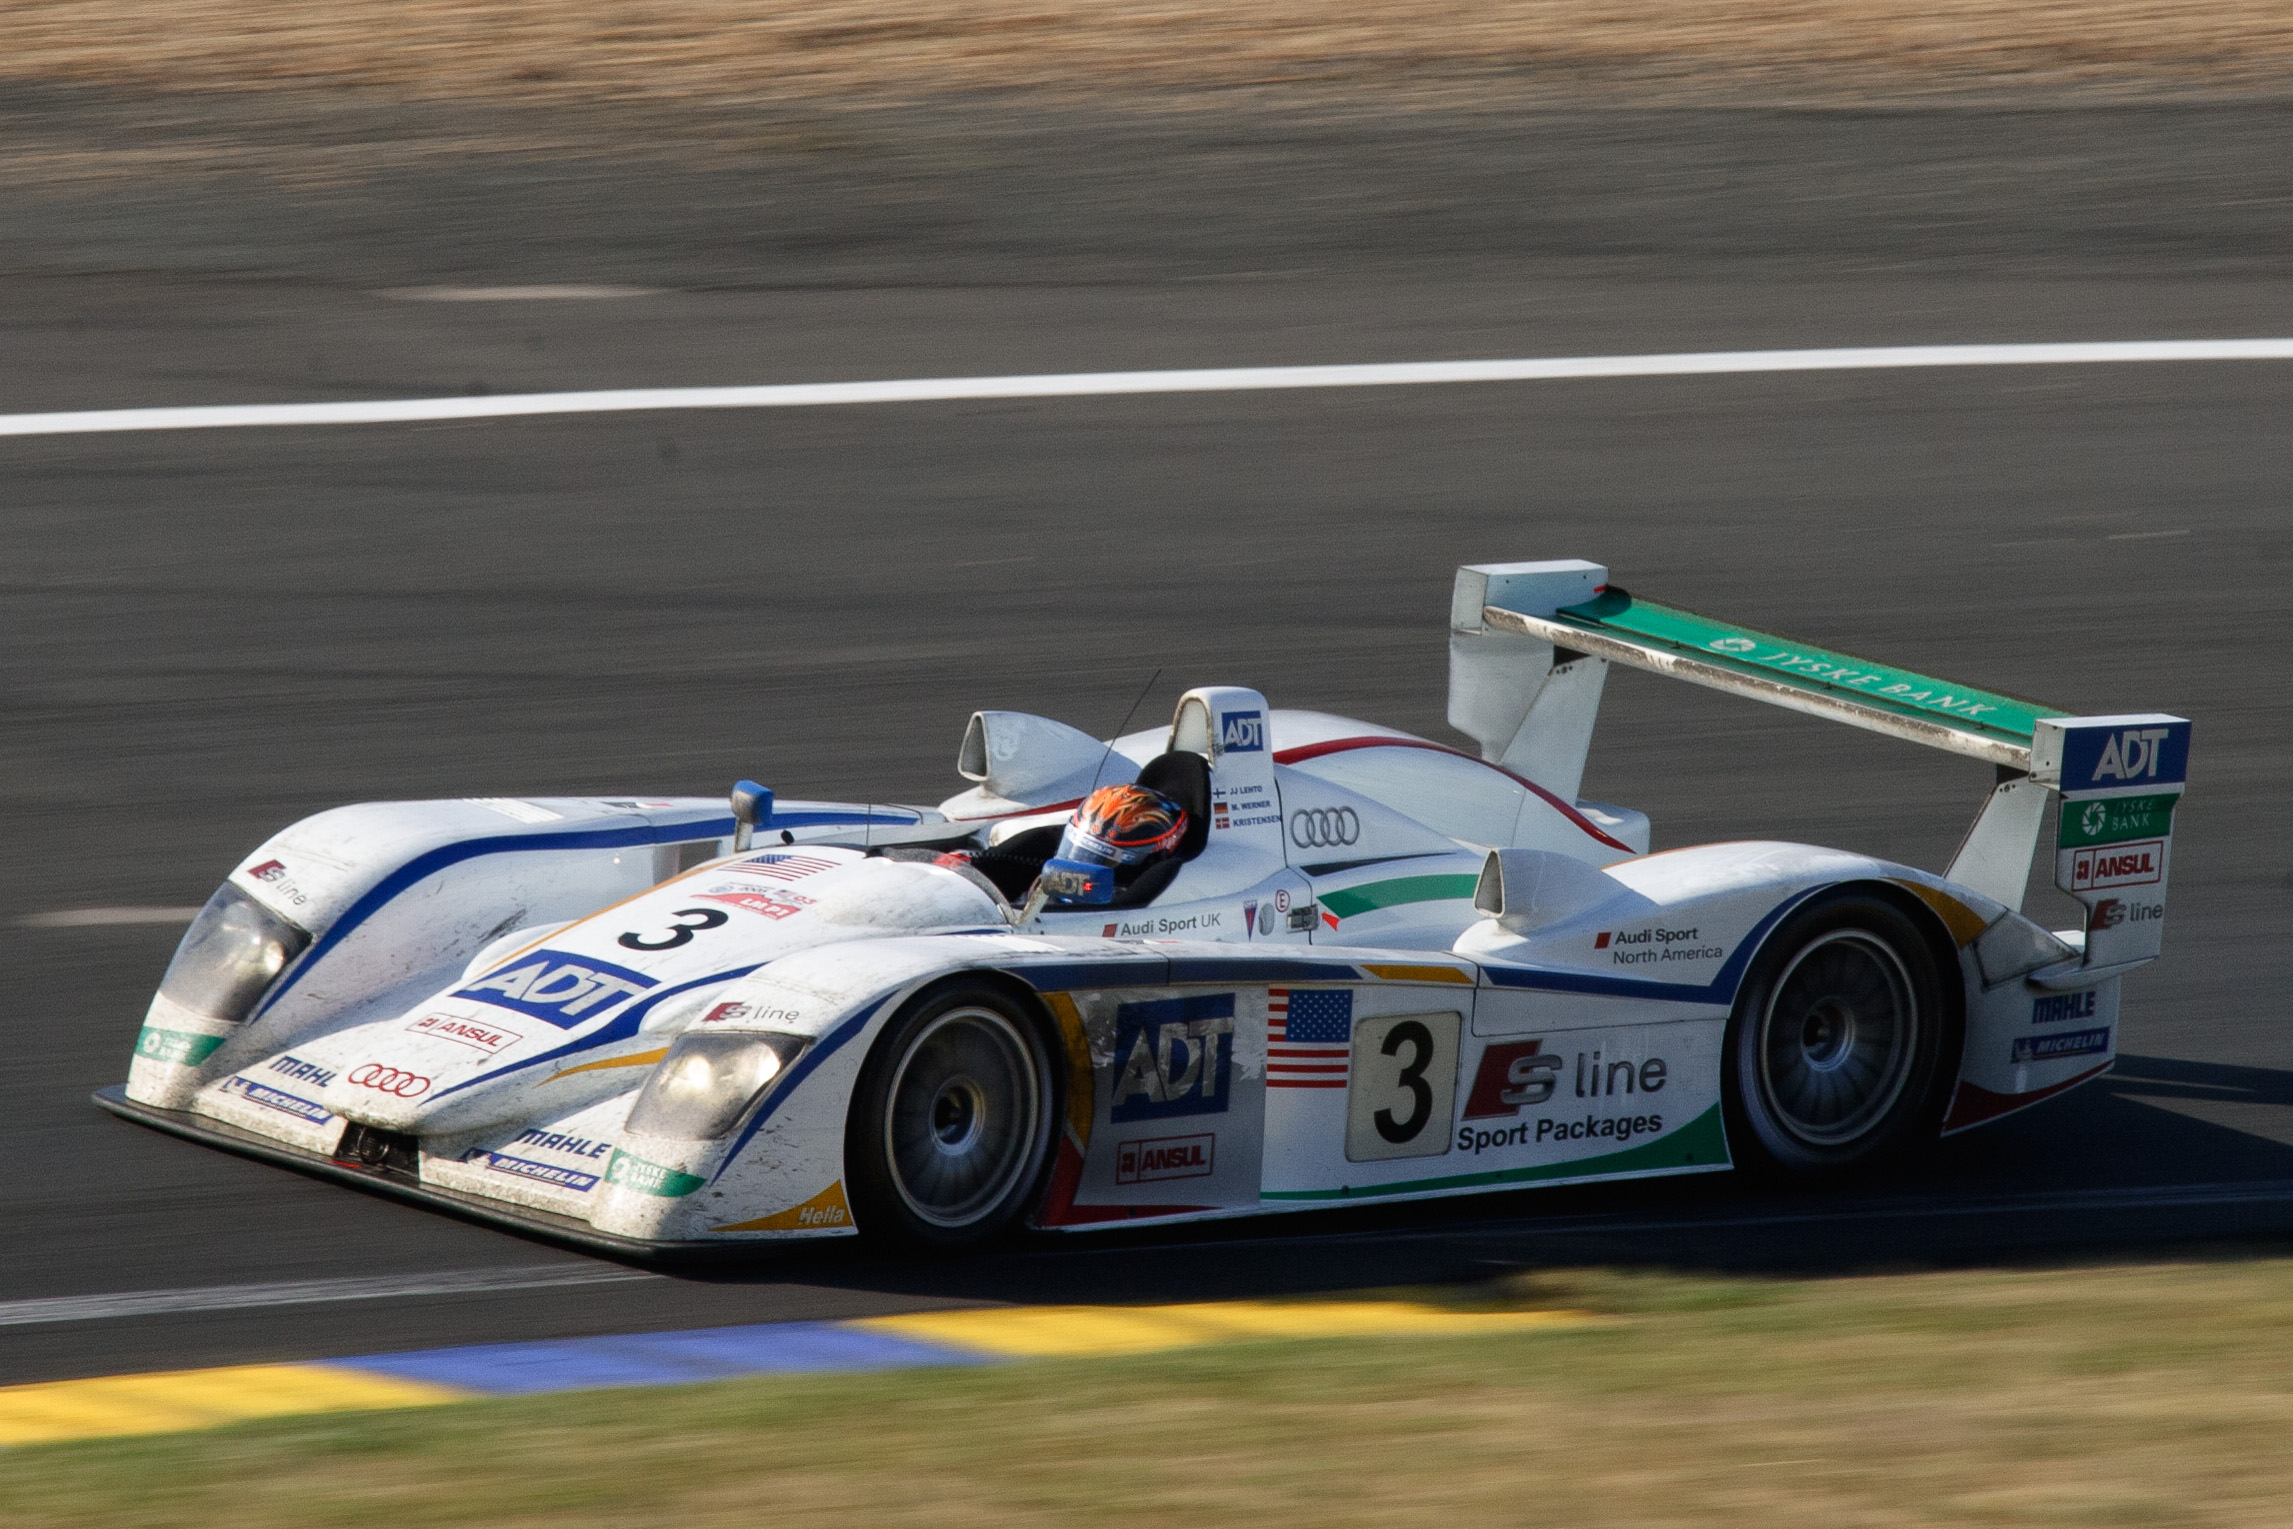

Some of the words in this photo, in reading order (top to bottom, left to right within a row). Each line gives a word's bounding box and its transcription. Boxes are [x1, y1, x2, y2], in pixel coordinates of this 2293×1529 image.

[1758, 651, 1882, 686] JYSKE
[1879, 683, 1998, 716] BANK
[1224, 717, 1261, 747] ADT
[2091, 728, 2169, 782] ADT
[1230, 787, 1239, 796] JJ
[1240, 785, 1262, 795] LEHTO
[1241, 800, 1271, 811] WERNER
[2114, 799, 2156, 815] JYSKE
[1233, 814, 1282, 828] KRISTENSEN
[2112, 813, 2150, 831] BANK
[2095, 853, 2154, 878] ANSUL
[276, 878, 307, 906] line
[1121, 920, 1154, 937] Audi
[1158, 917, 1197, 934] Sport
[1201, 913, 1221, 928] UK
[2130, 902, 2163, 922] line
[617, 908, 729, 951] 3
[1615, 929, 1652, 945] Audi
[1655, 928, 1698, 945] Sport
[1613, 950, 1657, 964] North
[1661, 945, 1723, 961] America
[460, 960, 649, 1016] ADT
[753, 1005, 800, 1020] line
[2032, 991, 2096, 1024] MAHLE
[438, 1021, 504, 1048] ANSUL
[2037, 1032, 2105, 1054] MICHELIN
[269, 1055, 338, 1088] MAHL
[1112, 1016, 1235, 1108] ADT
[1575, 1050, 1667, 1098] line
[1373, 1020, 1434, 1144] 3
[515, 1128, 613, 1159] MAHLE
[1457, 1121, 1527, 1155] Sport
[1536, 1113, 1663, 1143] Packages
[494, 1157, 594, 1187] MICHELIN
[1141, 1145, 1206, 1172] ANSUL
[798, 1205, 845, 1225] Hella
